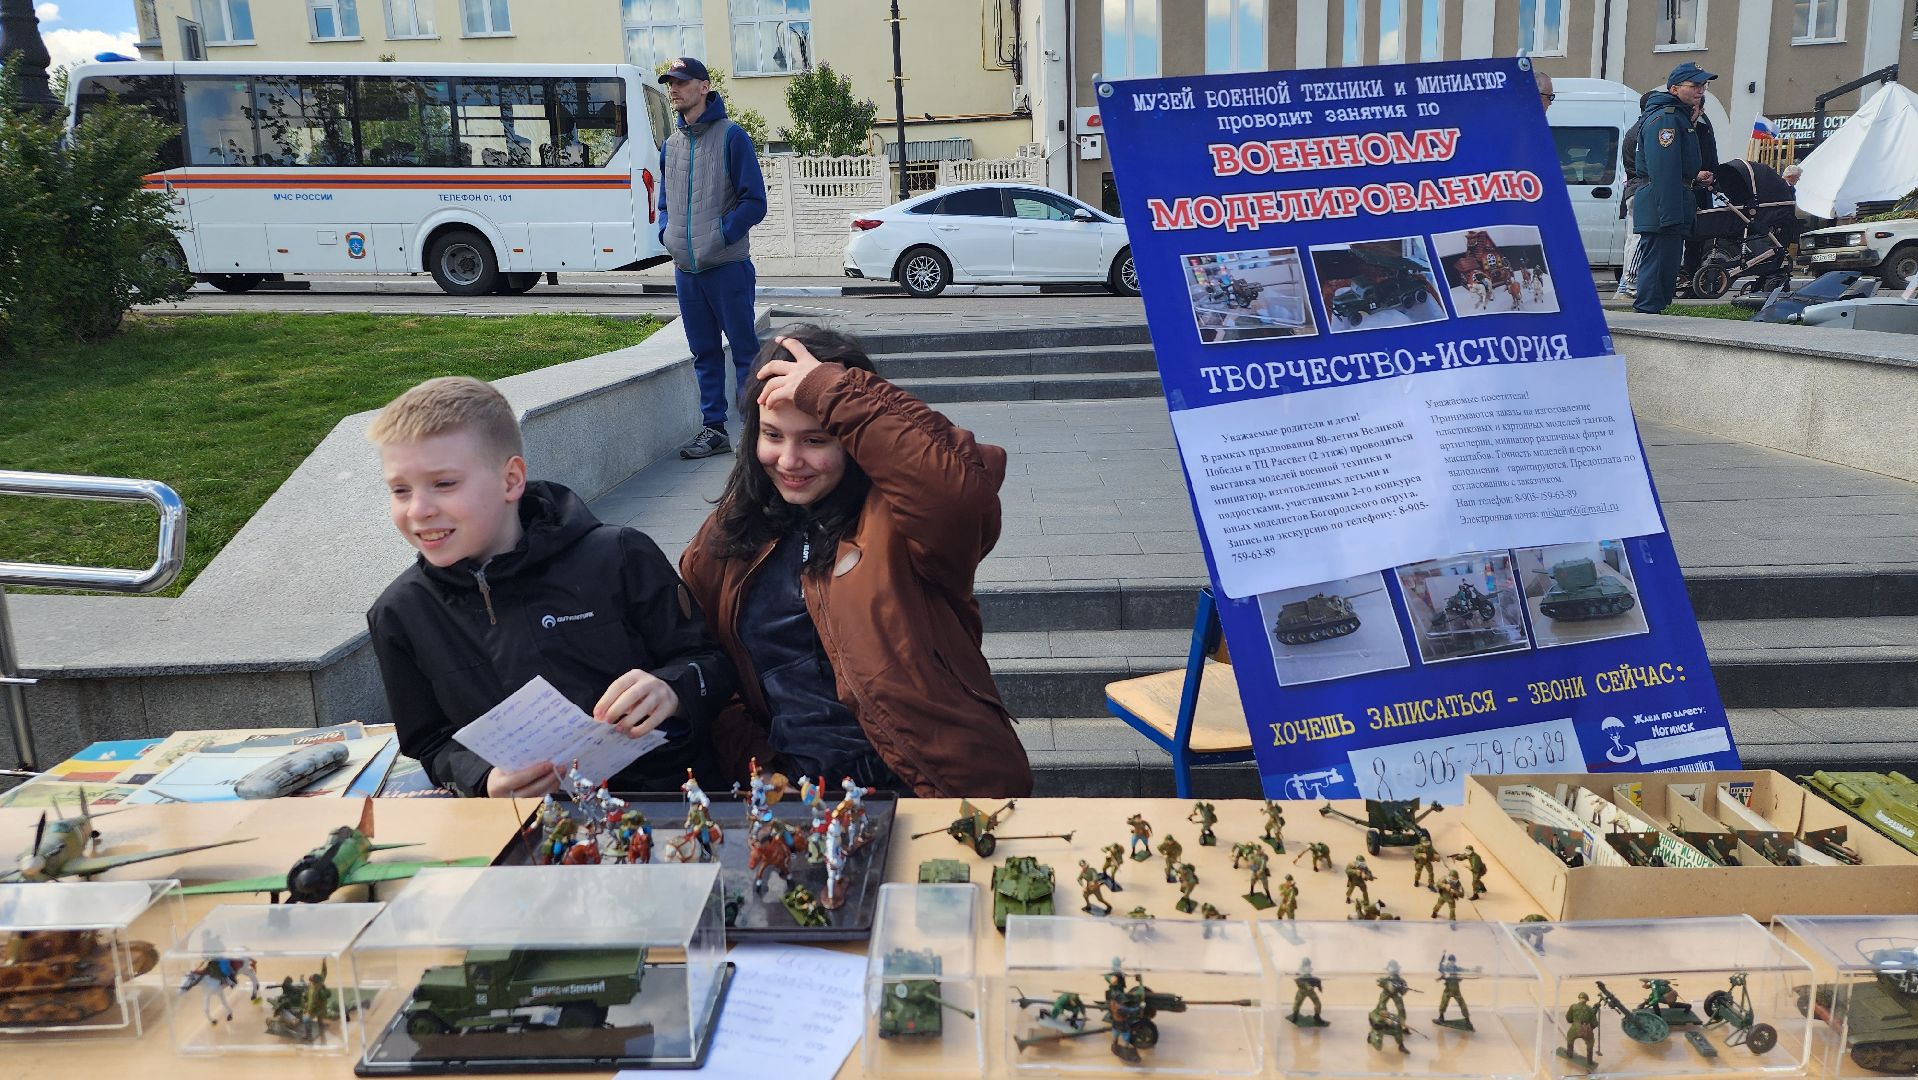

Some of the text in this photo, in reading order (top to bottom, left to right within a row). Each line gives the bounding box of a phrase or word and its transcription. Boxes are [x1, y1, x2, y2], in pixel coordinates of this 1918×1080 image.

[1133, 71, 1507, 112] МУЗЕЙ ВОЕННОЙ ТЕХНИКИ и МИНИАТЮР
[1217, 101, 1440, 134] проводит занятия по
[1208, 128, 1460, 177] ВОЕННОМУ
[273, 193, 333, 201] МЧС РОССИИ
[439, 194, 512, 202] ТЕЛЕФОН 01, 101
[1148, 171, 1543, 232] МОДЕЛИРОВАНИЮ
[1200, 333, 1571, 394] ТВОРЧЕСТВО+ИСТОРИЯ
[1425, 396, 1479, 409] Уважаемые
[1430, 410, 1495, 425] Принимаются
[1496, 408, 1522, 417] заказы
[1535, 403, 1591, 415] изготовление
[1201, 419, 1405, 464] В рамках празднования 80-летия Великой
[1221, 428, 1279, 443] Уважаемые
[1280, 421, 1324, 436] родители
[1335, 412, 1361, 426] дети!
[1435, 424, 1494, 436] пластиковых
[1502, 421, 1545, 432] картонных
[1545, 416, 1581, 428] моделей
[1582, 415, 1616, 425] танков,
[1536, 433, 1580, 445] различных
[1582, 428, 1606, 440] фирм
[1205, 464, 1243, 478] Победы
[1252, 459, 1270, 470] ТЦ
[1271, 453, 1308, 466] Рассвет
[1308, 450, 1319, 462] (2
[1321, 446, 1348, 459] этаж)
[1350, 432, 1414, 453] проводиться
[1444, 451, 1494, 464] масштабов.
[1494, 449, 1532, 459] Точность
[1533, 446, 1568, 458] моделей
[1576, 444, 1602, 455] сроки
[1448, 466, 1500, 477] выполнения
[1570, 454, 1622, 469] Предоплата
[1623, 454, 1636, 462] по
[1210, 452, 1392, 492] выставка моделей военной техники и
[1214, 492, 1267, 506] миниатюр,
[1269, 478, 1342, 497] изготовленных
[1344, 469, 1381, 484] детьми
[1218, 475, 1422, 520] подростками, участниками 2-го конкурса
[1223, 491, 1419, 534] юных моделистов Богородского округа.
[1227, 537, 1262, 549] Запись
[1279, 524, 1329, 539] экскурсию
[1331, 521, 1343, 530] по
[1345, 510, 1397, 526] телефону:
[1399, 501, 1430, 515] 8-905-
[1460, 512, 1513, 525] Электронная
[1514, 511, 1539, 520] почта:
[1231, 547, 1276, 563] 759-63-89
[1268, 713, 1356, 746] ХОЧЕШЬ
[1367, 690, 1496, 731] ЗАПИСАТЬСЯ
[1527, 676, 1587, 705] ЗВОНИ
[1595, 663, 1687, 695] СЕЙЧАС:
